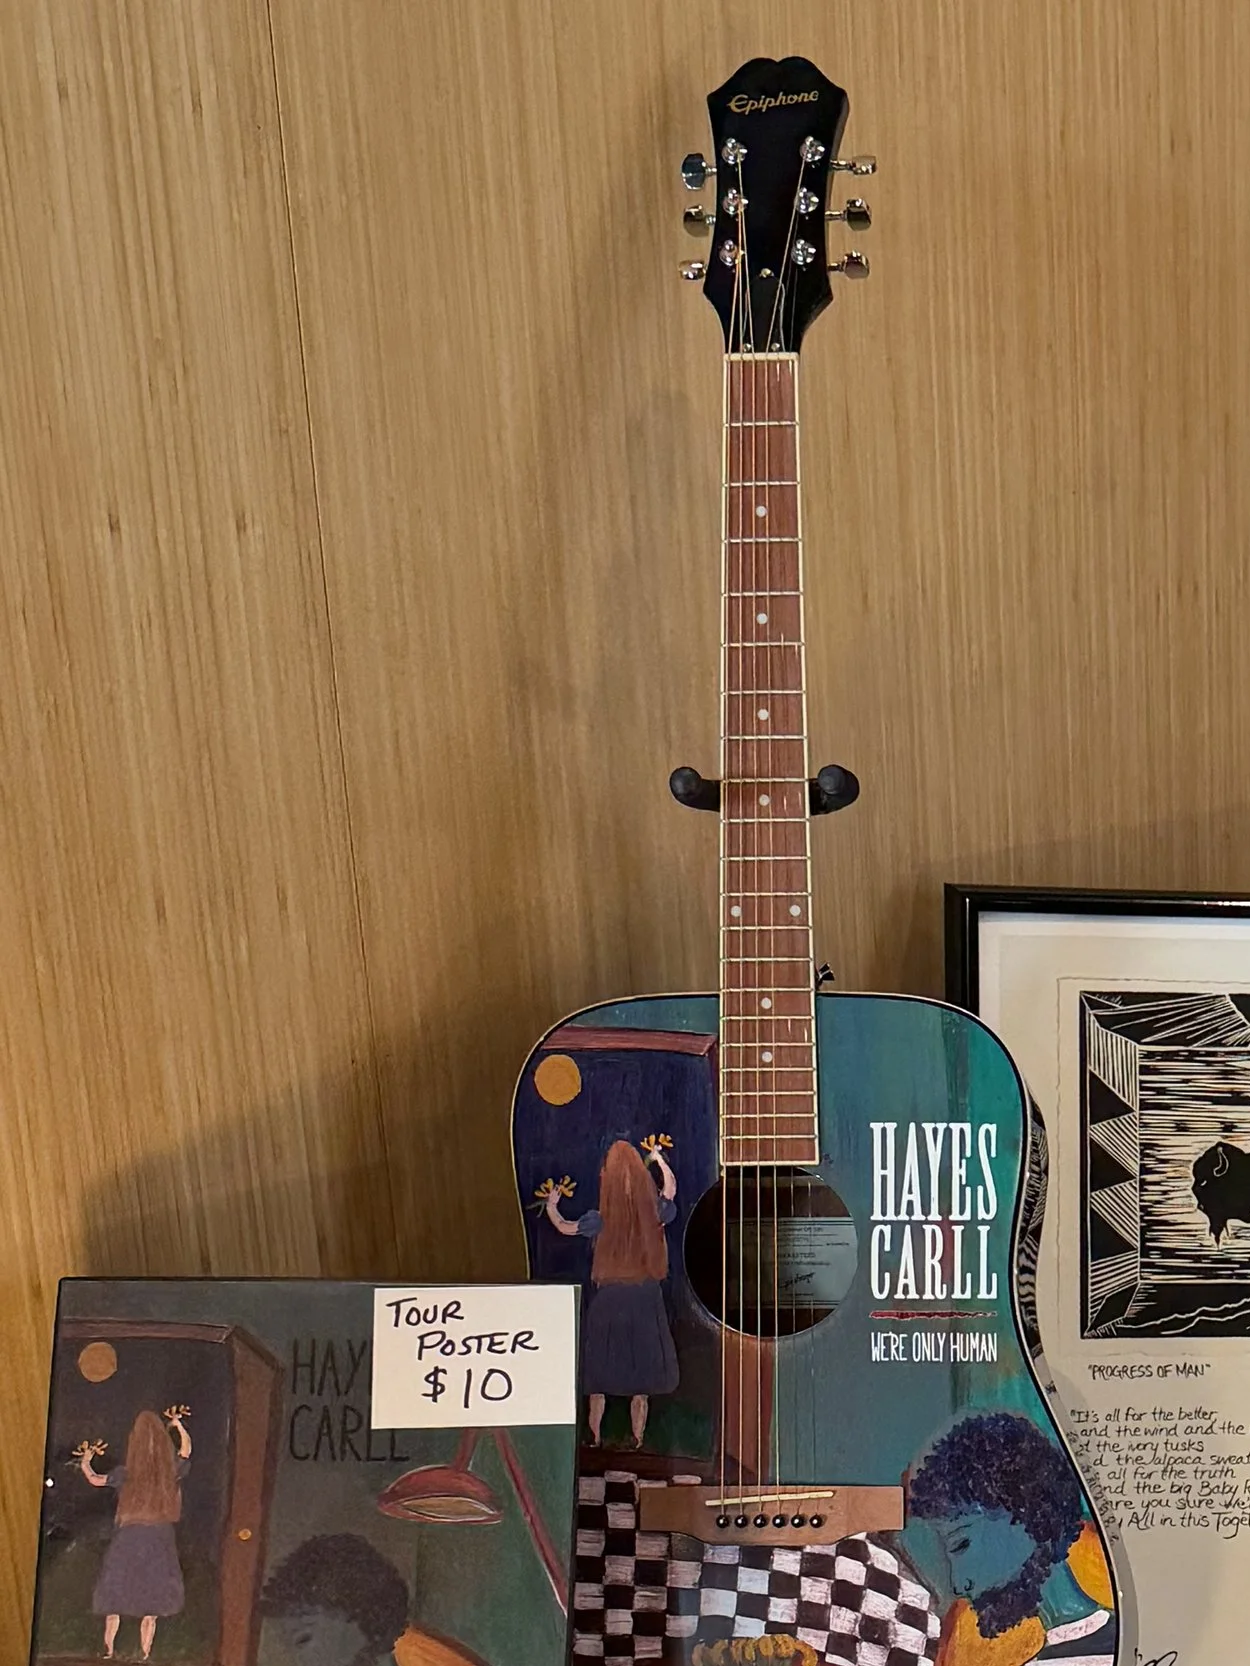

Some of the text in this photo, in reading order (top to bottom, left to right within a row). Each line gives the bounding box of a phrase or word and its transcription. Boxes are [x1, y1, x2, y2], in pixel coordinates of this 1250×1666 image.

[727, 90, 819, 115] Epiphone
[870, 1122, 997, 1221] HAYES
[870, 1224, 997, 1300] CARLL
[417, 1330, 539, 1361] POSTER
[871, 1331, 997, 1362] WE'RE ONLY HUMAN
[291, 1337, 372, 1396] HAY
[1157, 1364, 1172, 1377] OF
[1105, 1407, 1174, 1422] all for the
[1080, 1425, 1110, 1437] and
[1116, 1425, 1142, 1436] the
[1144, 1424, 1178, 1437] wind
[1185, 1422, 1215, 1435] and
[1219, 1422, 1245, 1434] the
[1096, 1441, 1124, 1452] the
[1164, 1441, 1204, 1452] tusks
[1116, 1454, 1150, 1465] the
[1107, 1467, 1236, 1480] all for the truth
[1134, 1482, 1168, 1494] the
[1170, 1482, 1192, 1501] big
[1199, 1480, 1239, 1502] Baby
[1141, 1497, 1215, 1510] you sure
[1128, 1511, 1155, 1530] All
[1160, 1515, 1174, 1527] in
[1180, 1513, 1210, 1527] this
